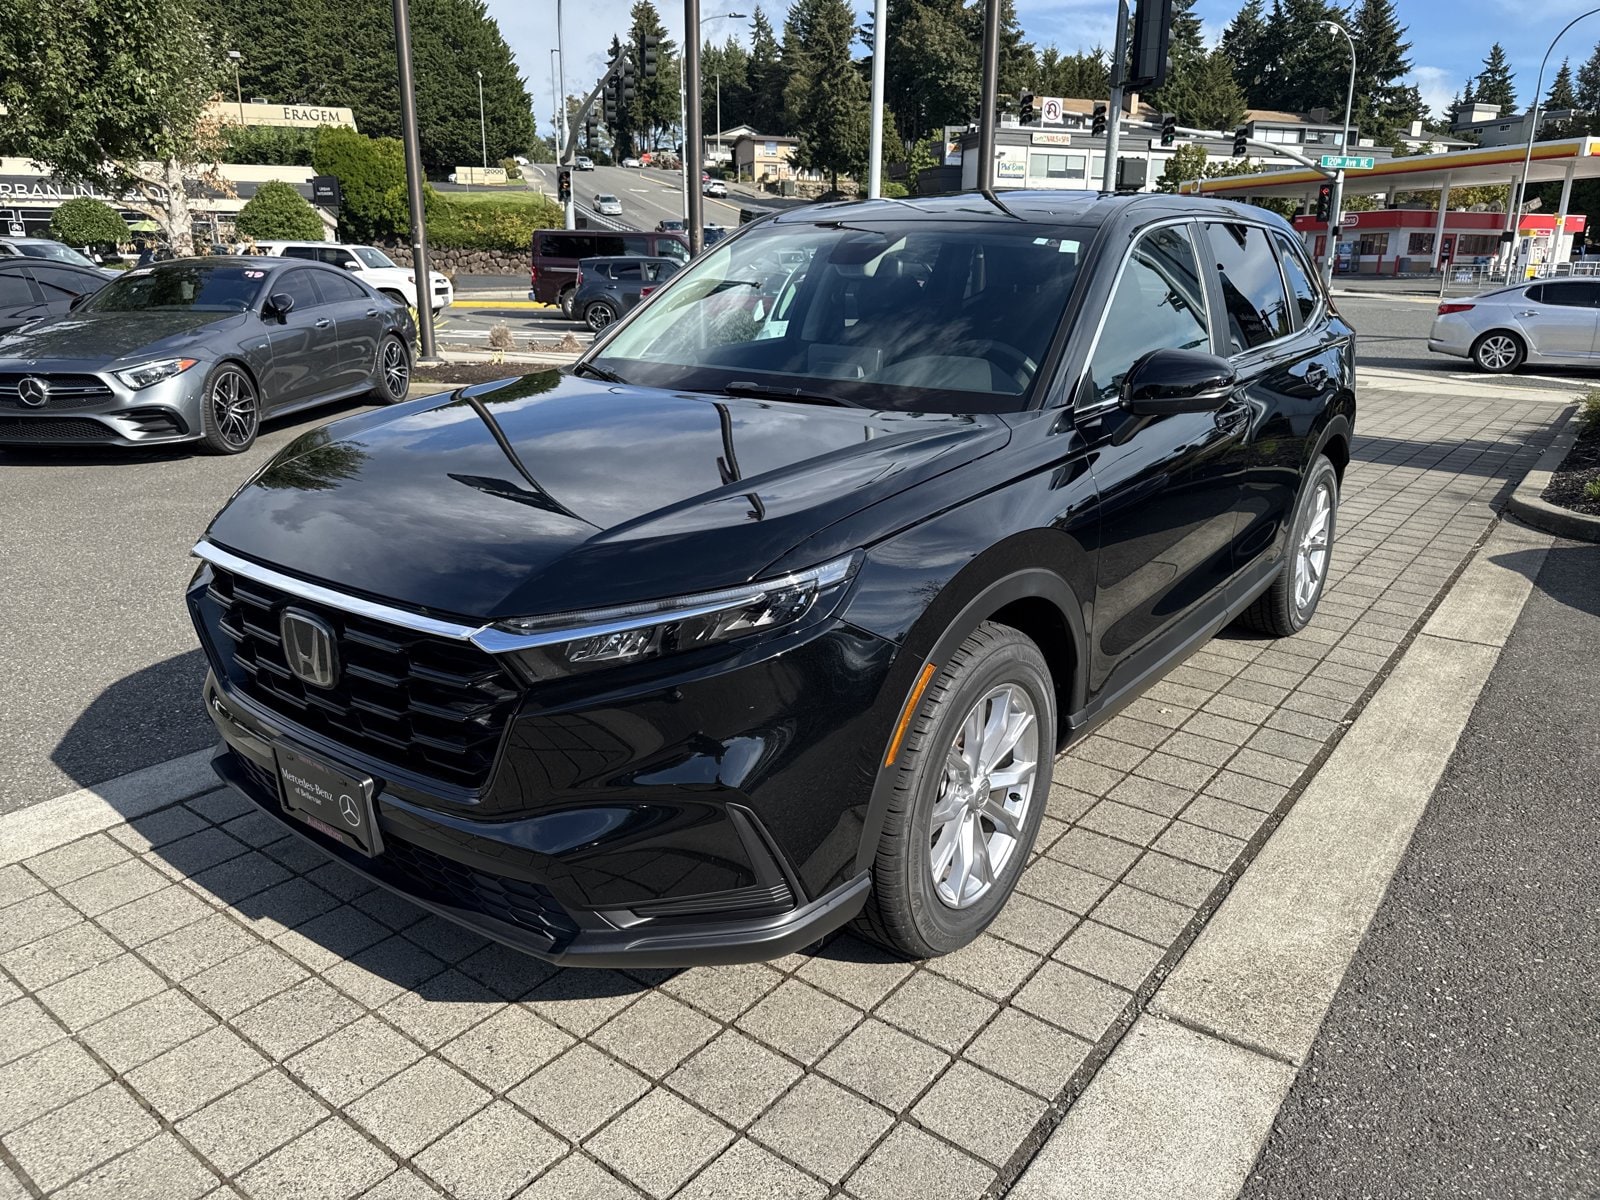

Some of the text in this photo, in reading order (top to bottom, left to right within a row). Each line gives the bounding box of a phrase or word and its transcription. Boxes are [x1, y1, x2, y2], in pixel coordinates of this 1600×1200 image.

[1328, 157, 1369, 168] 120th Ave NE
[281, 767, 334, 802] Mercedes-Benz
